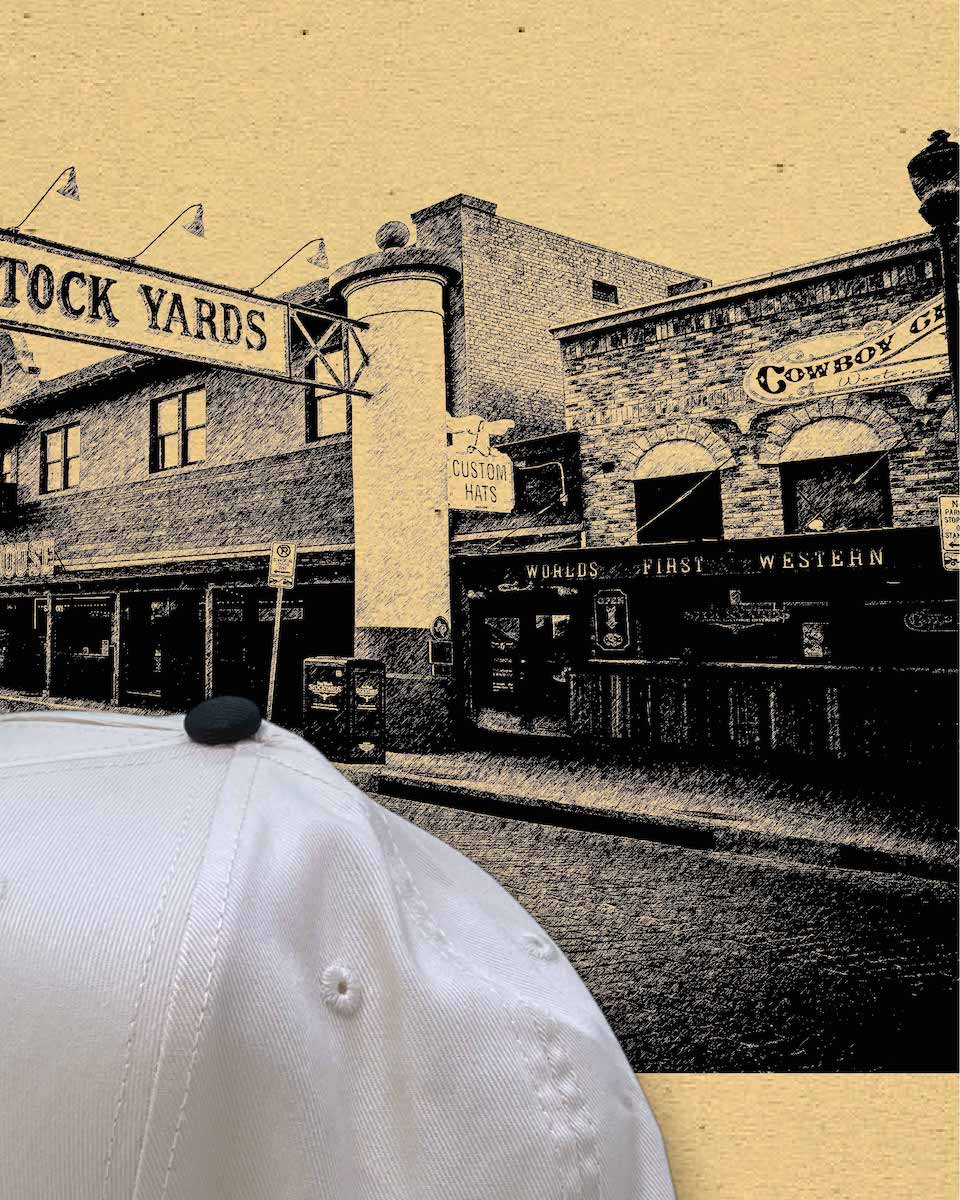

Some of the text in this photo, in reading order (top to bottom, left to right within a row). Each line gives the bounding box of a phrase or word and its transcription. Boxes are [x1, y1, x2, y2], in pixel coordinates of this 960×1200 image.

[138, 283, 268, 352] YARDS
[755, 332, 897, 395] COWBOY
[452, 459, 507, 481] CUSTOM
[465, 483, 497, 503] HATS
[759, 546, 884, 570] WESTERN
